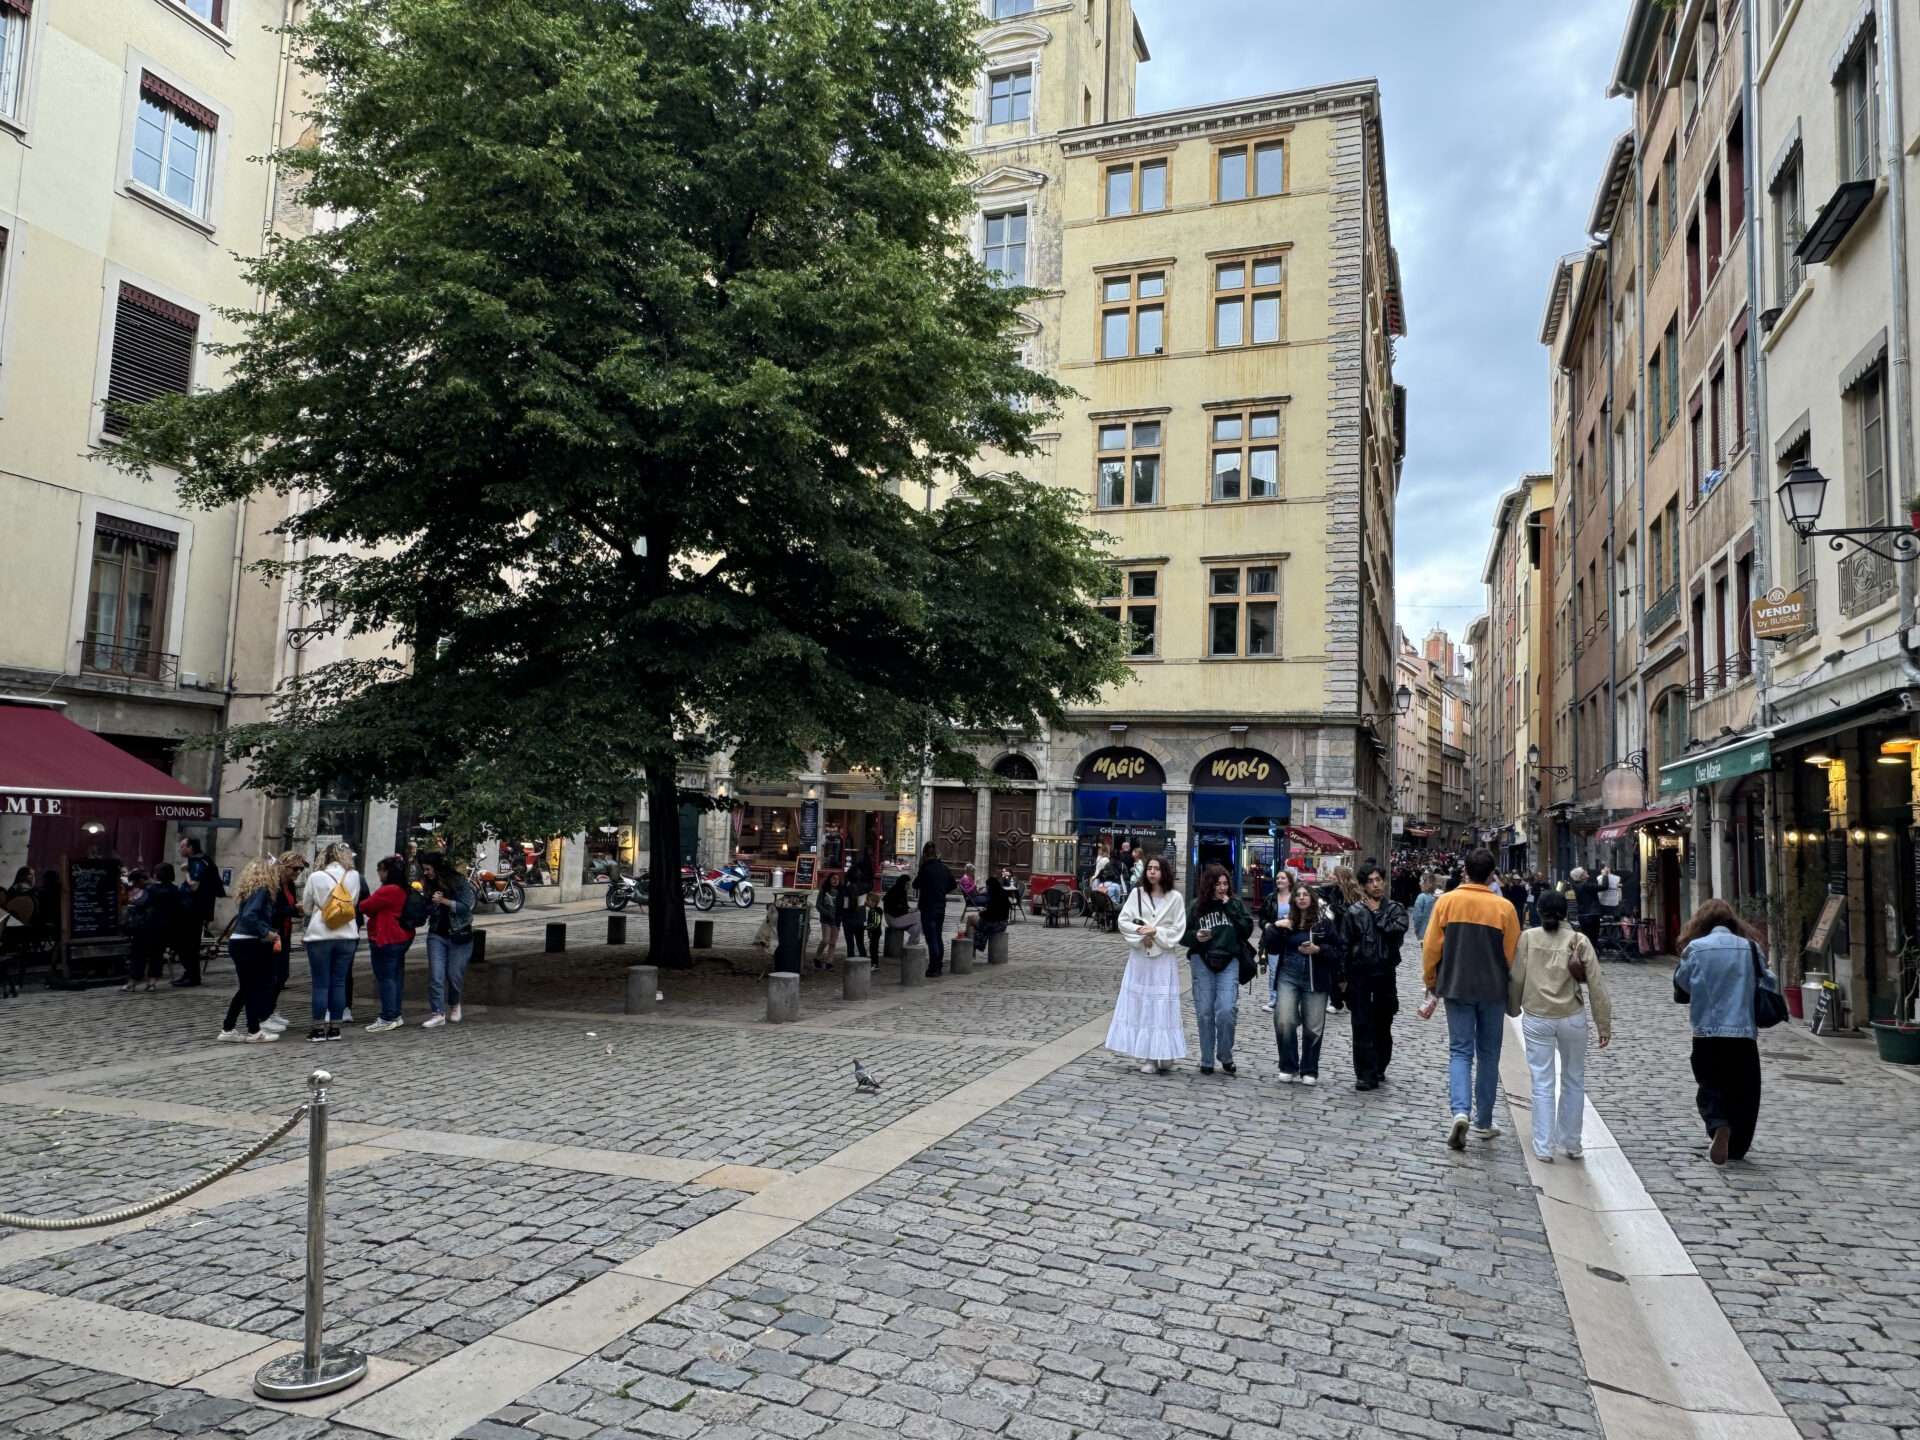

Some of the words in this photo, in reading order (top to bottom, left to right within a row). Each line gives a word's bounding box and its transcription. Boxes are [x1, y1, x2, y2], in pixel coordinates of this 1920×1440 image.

[1756, 603, 1801, 619] VENDU
[1757, 620, 1769, 630] by
[1211, 757, 1270, 781] WORLD
[0, 796, 62, 815] MIE
[155, 805, 205, 818] LYONNAIS
[1200, 911, 1232, 930] CHICA
